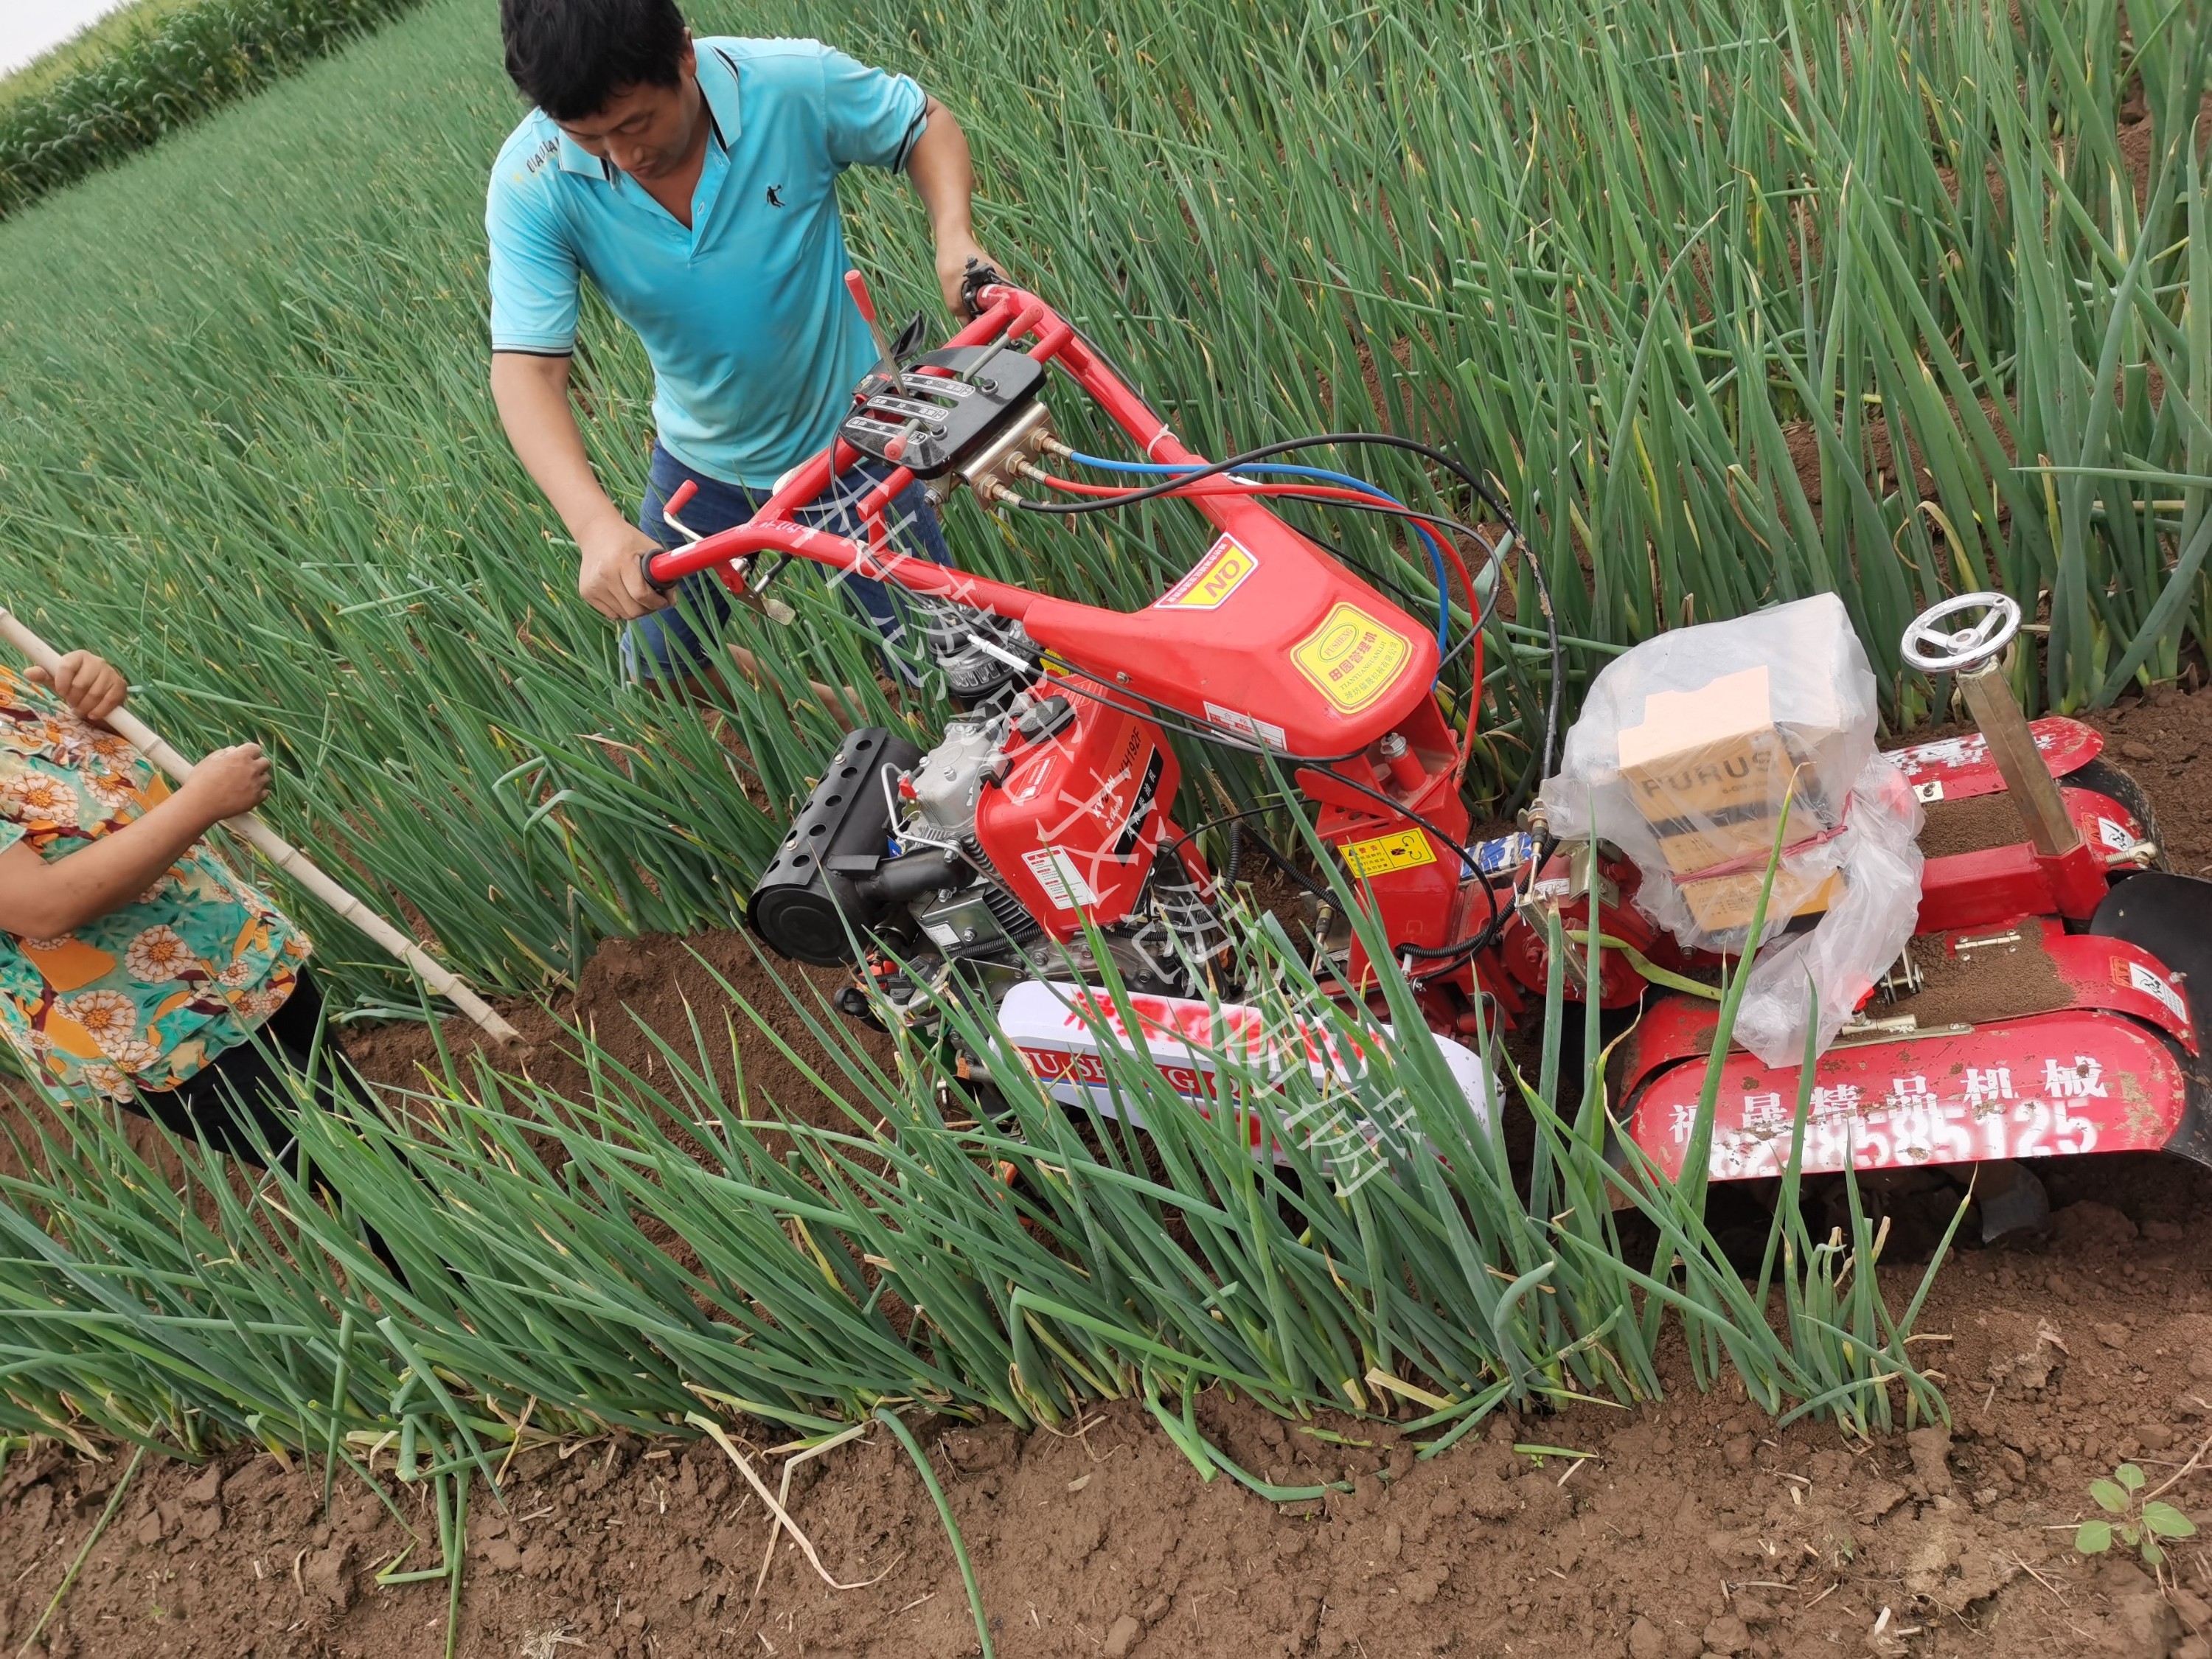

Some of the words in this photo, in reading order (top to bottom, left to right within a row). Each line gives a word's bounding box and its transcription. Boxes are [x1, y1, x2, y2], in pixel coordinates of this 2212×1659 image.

[1324, 627, 1353, 657] FUSHENG
[1328, 631, 1377, 682] 田园管理机
[1126, 768, 1157, 842] 风冷柴油机
[1358, 844, 1379, 855] 警告
[1074, 1055, 1196, 1090] SHG
